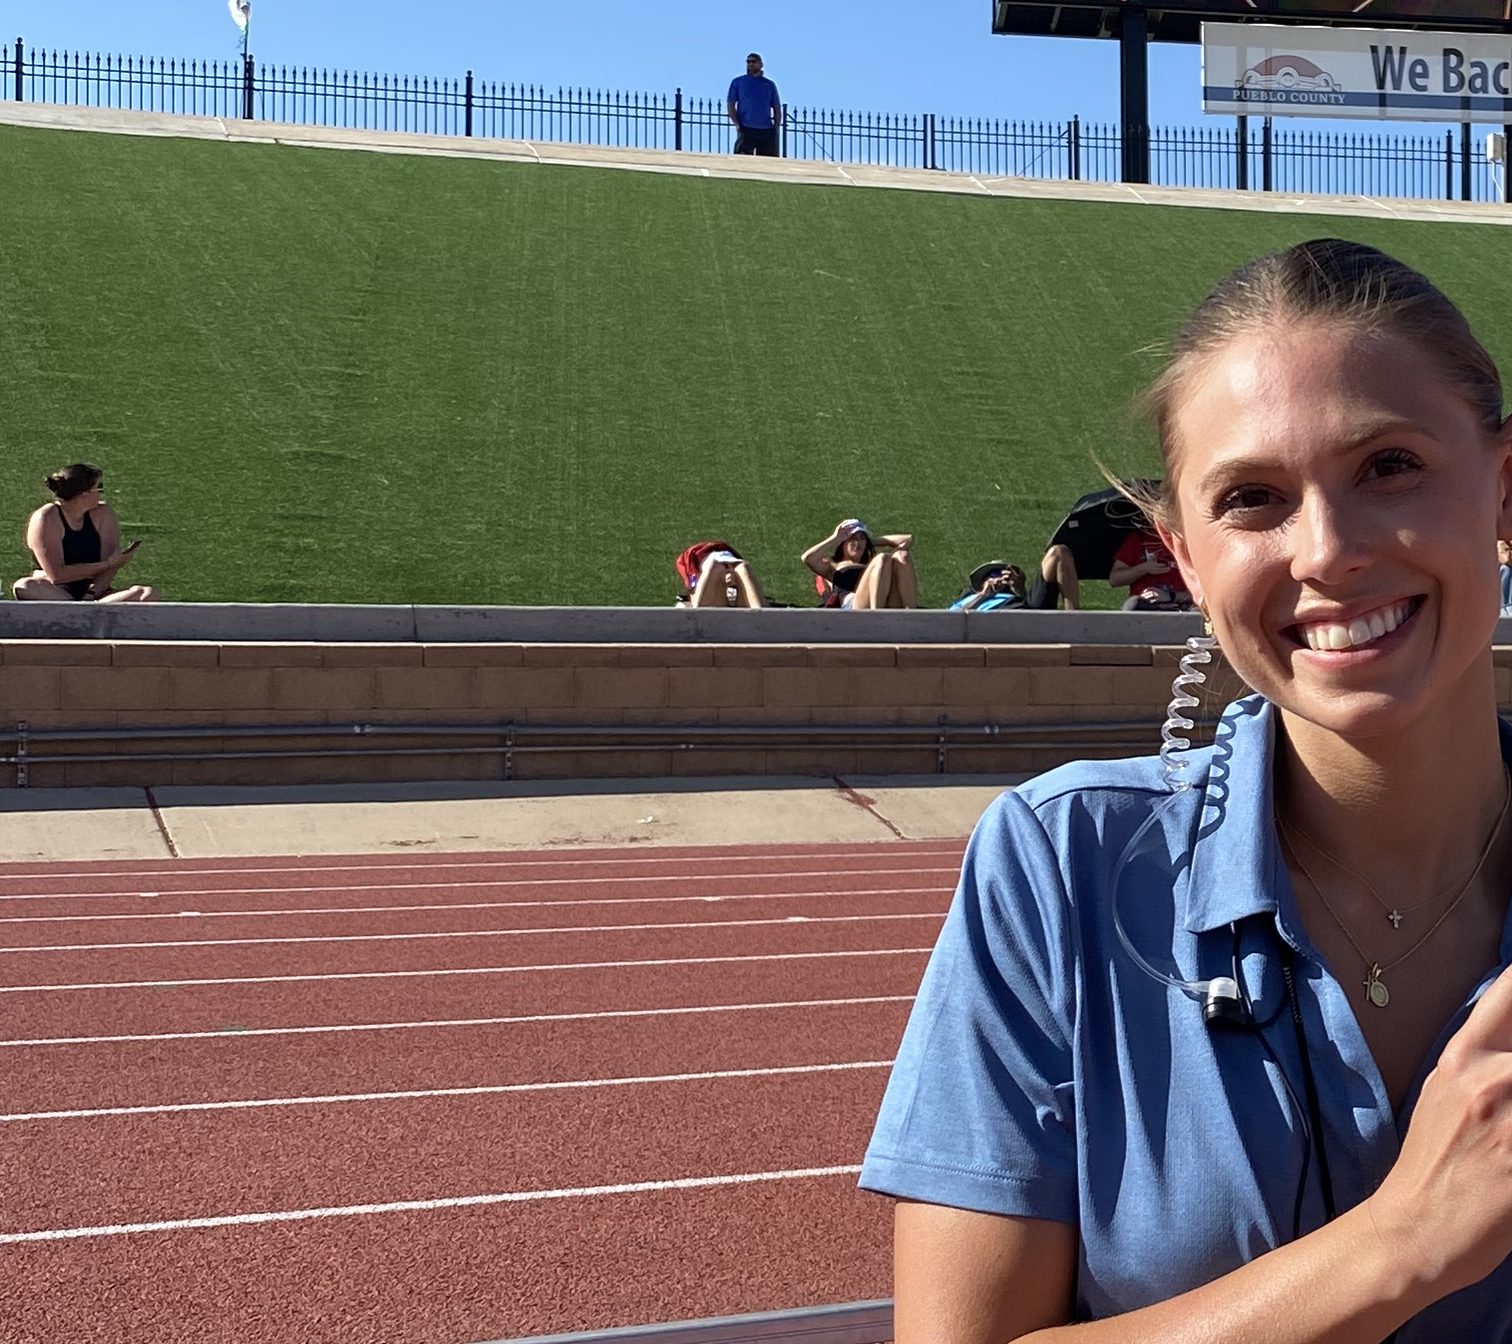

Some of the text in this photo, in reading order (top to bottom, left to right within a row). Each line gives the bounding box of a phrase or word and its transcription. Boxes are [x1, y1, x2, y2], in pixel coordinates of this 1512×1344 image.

[1370, 44, 1430, 92] We
[1232, 89, 1346, 104] PUEBLO COUNTY
